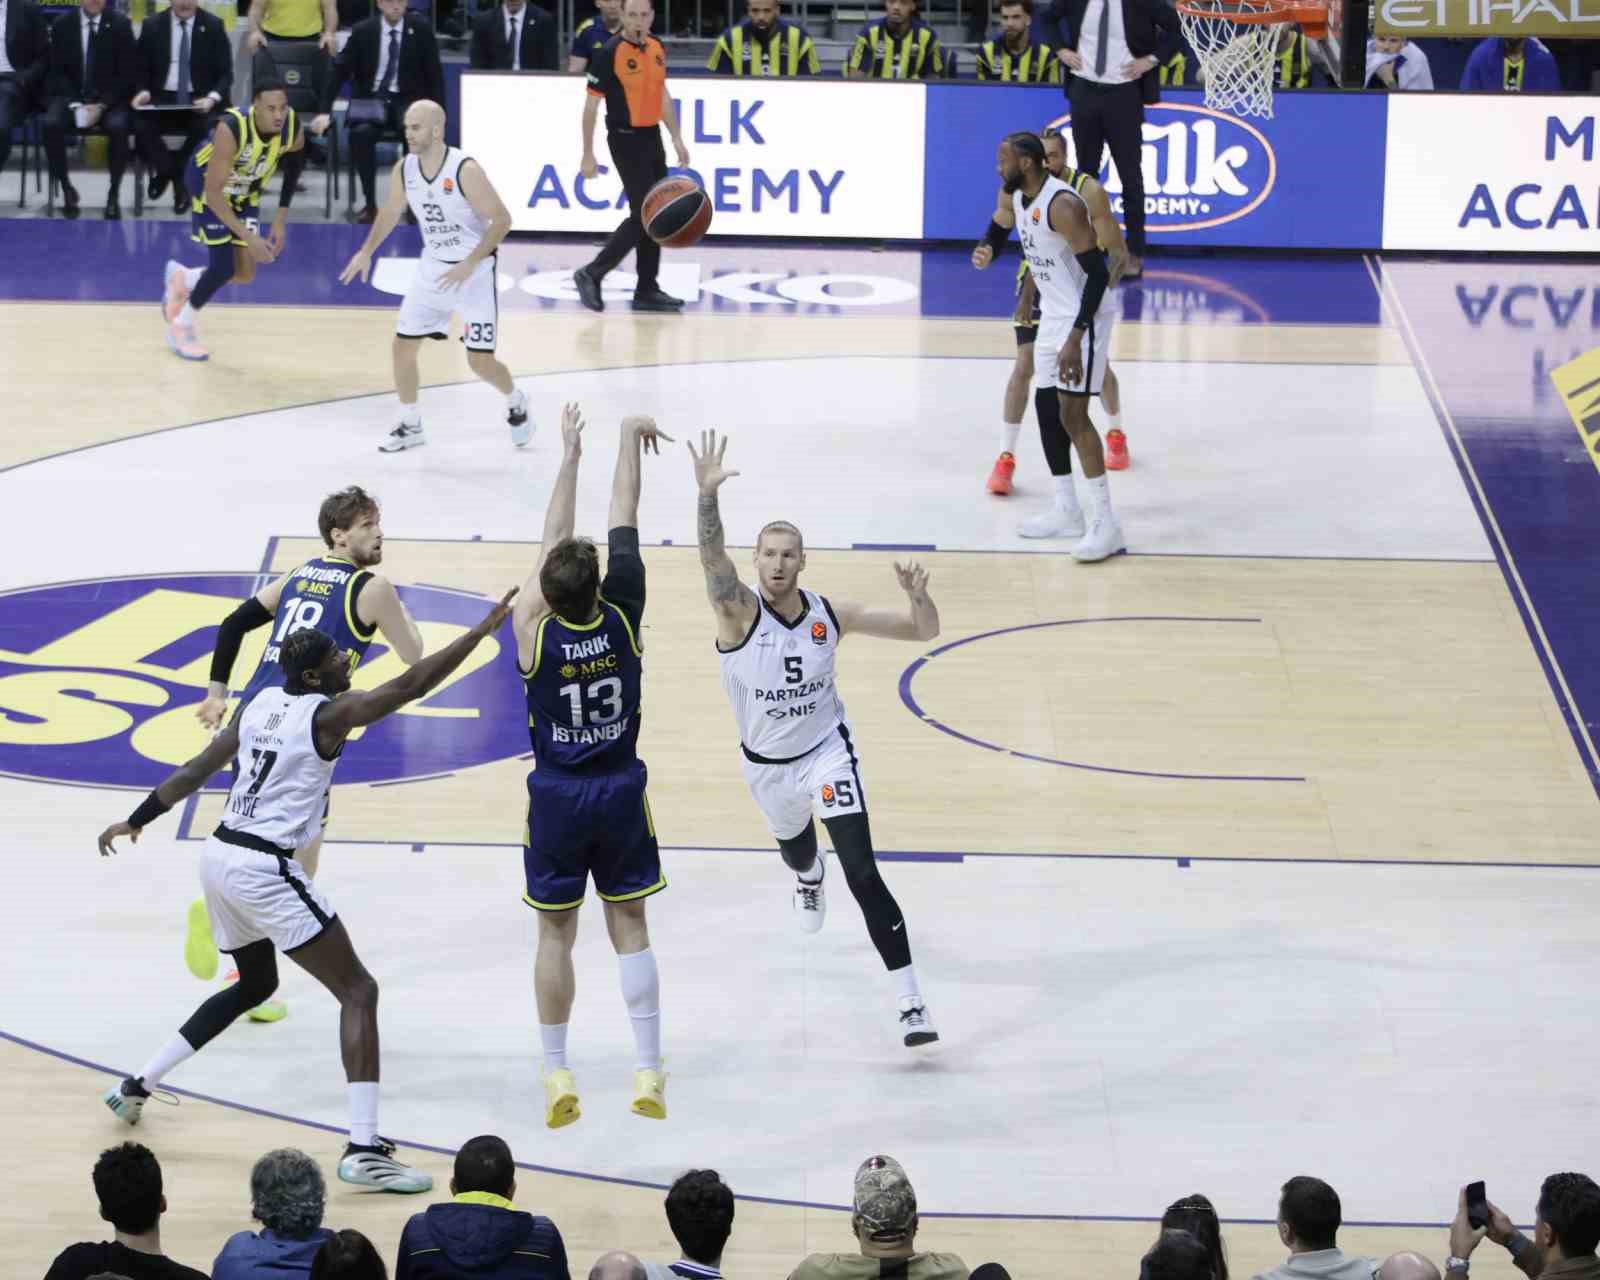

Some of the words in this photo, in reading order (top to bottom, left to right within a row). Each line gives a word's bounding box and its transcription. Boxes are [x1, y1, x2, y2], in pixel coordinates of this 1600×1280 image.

[671, 98, 766, 145] ILK
[422, 203, 445, 223] 33
[1458, 183, 1600, 229] ACA
[470, 322, 495, 343] 33
[561, 633, 611, 660] TARIK
[580, 654, 617, 675] MSC
[784, 656, 804, 684] 5
[560, 676, 623, 728] 13
[755, 678, 825, 702] PARTIZAN
[835, 780, 856, 807] 5
